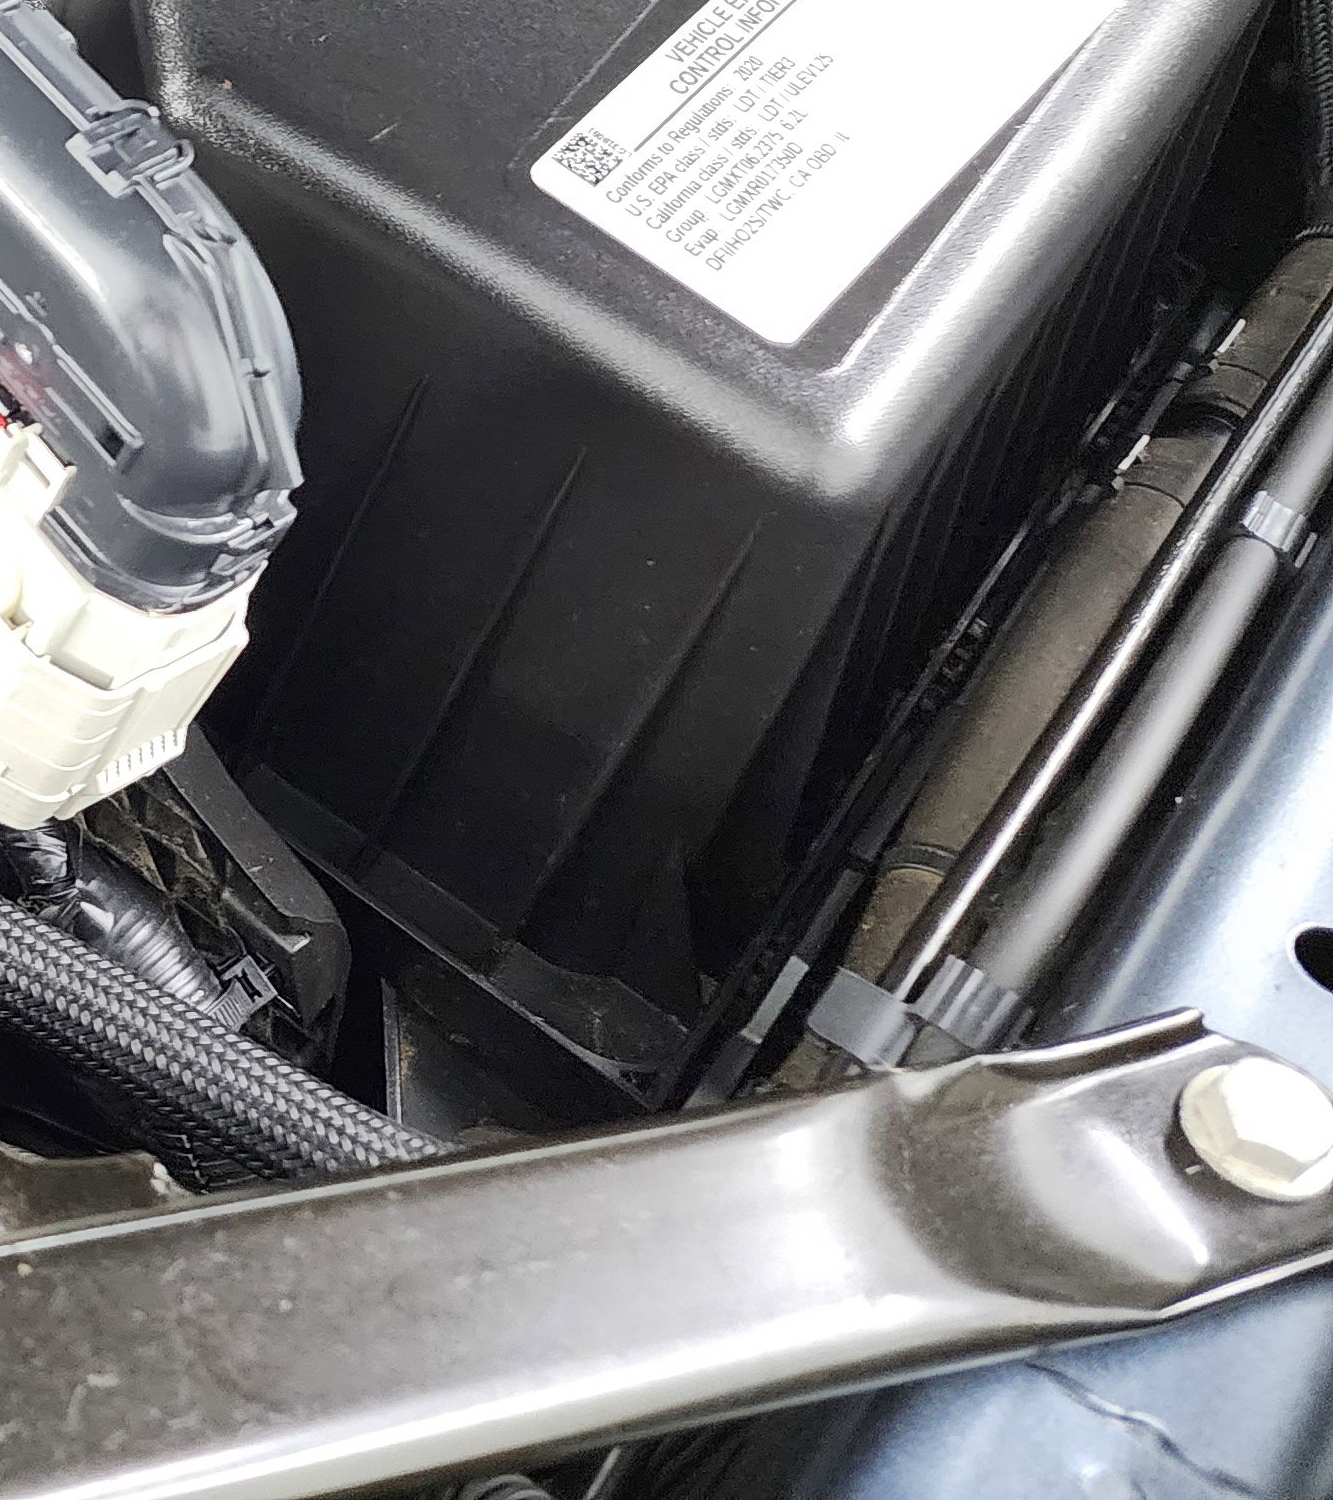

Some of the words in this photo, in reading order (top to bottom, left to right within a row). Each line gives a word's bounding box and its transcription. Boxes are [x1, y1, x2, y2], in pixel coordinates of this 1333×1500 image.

[664, 5, 734, 63] VEHICLE
[668, 32, 745, 95] CONTROL
[605, 153, 664, 204] Conforms
[656, 142, 675, 156] to
[732, 55, 764, 82] 2020
[624, 194, 655, 217] U.S.
[647, 171, 679, 196] EPA
[674, 145, 706, 173] class
[732, 88, 761, 113] LDT
[758, 56, 796, 87] TIER3
[645, 172, 710, 230] California
[699, 147, 734, 178] class
[757, 97, 785, 123] LDT
[783, 54, 834, 97] ULEV125
[704, 131, 785, 205] LGMXT06.2375
[779, 109, 809, 131] 6.2L
[788, 169, 813, 188] CA
[806, 143, 837, 170] OBD
